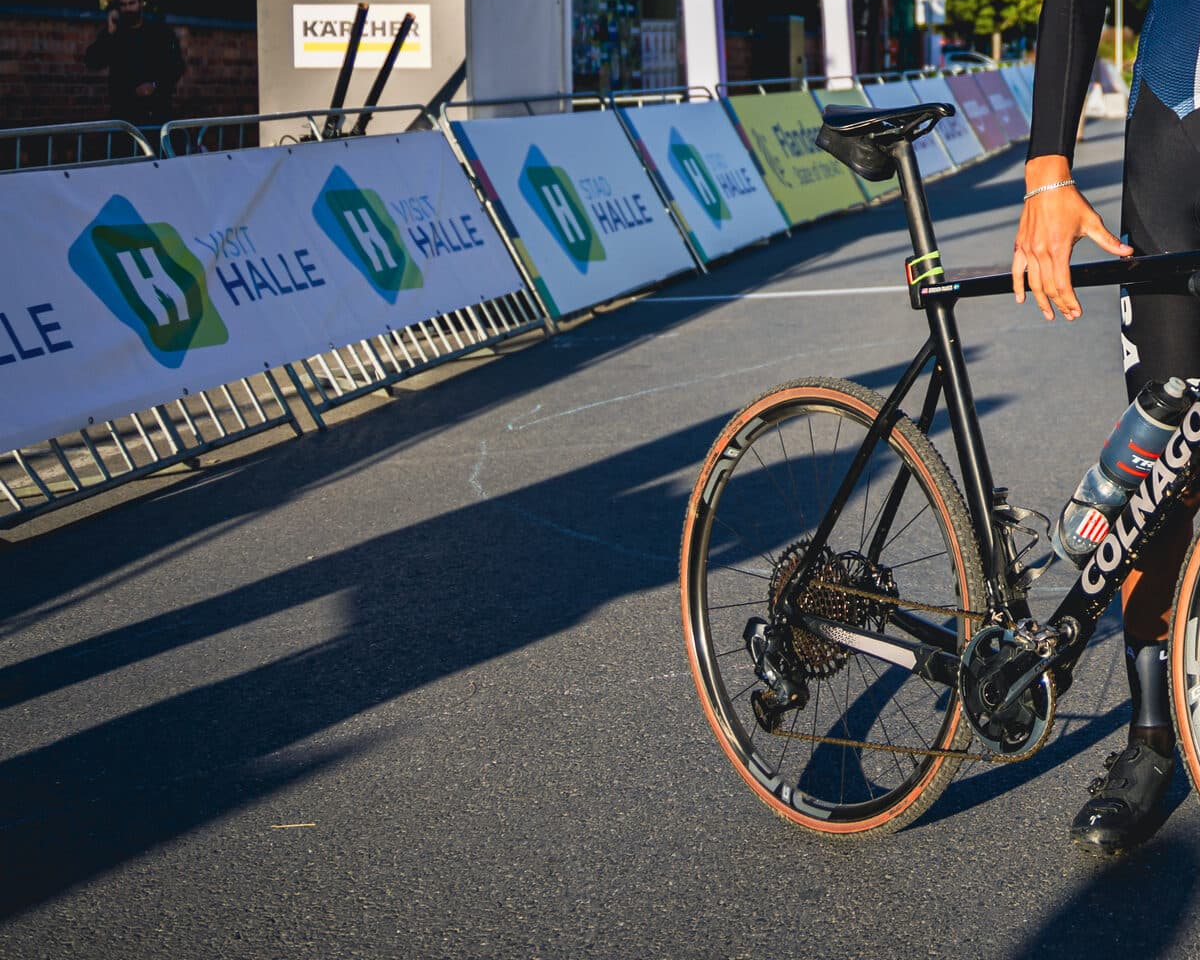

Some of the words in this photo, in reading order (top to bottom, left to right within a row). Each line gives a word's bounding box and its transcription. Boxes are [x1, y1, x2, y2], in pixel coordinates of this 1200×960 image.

[303, 19, 420, 38] KÄRHER
[719, 168, 757, 199] HALLE
[390, 195, 439, 223] VISIT
[592, 194, 653, 234] HALLE
[194, 226, 256, 259] VISIT
[408, 215, 484, 260] HALLE
[215, 248, 327, 307] HALLE
